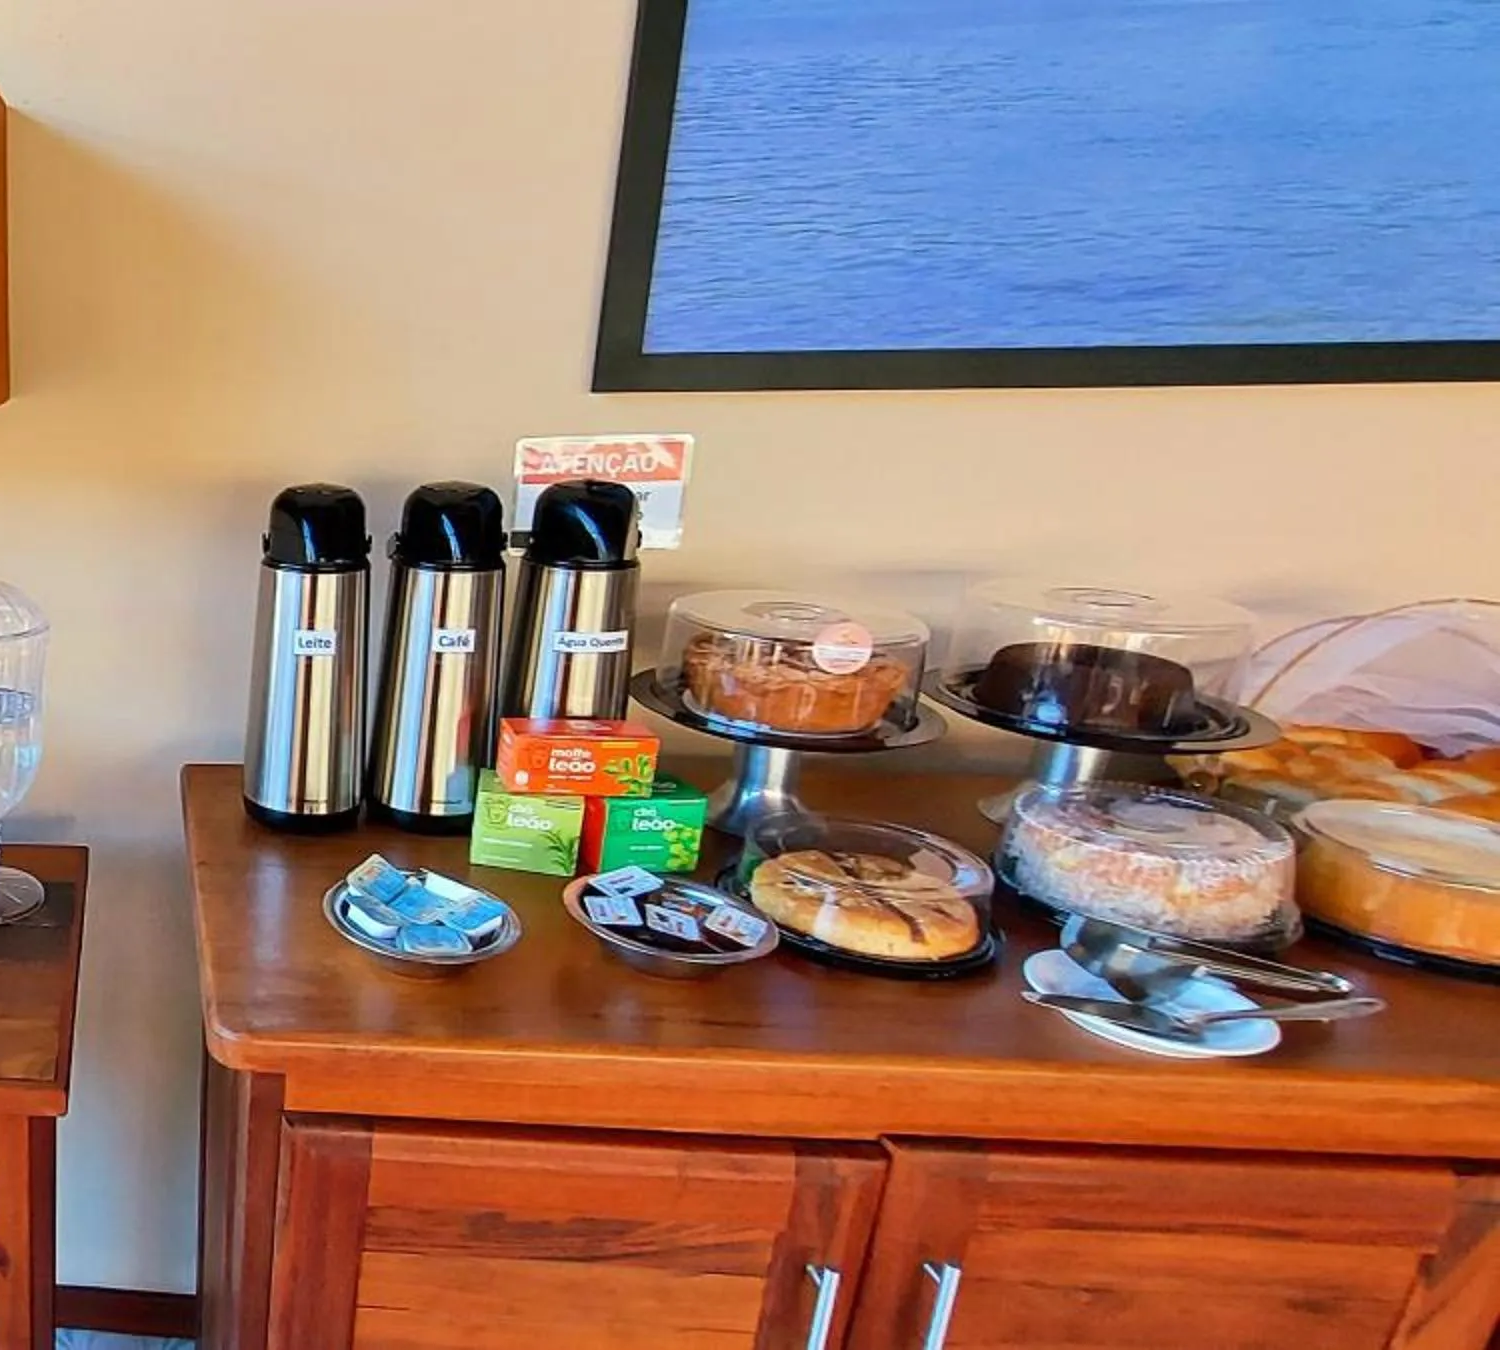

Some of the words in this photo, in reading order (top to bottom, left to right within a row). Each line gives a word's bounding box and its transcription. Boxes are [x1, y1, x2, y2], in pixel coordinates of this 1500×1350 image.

[298, 636, 332, 650] Leite
[438, 635, 471, 648] Café
[548, 757, 597, 773] leão
[632, 817, 677, 832] leão
